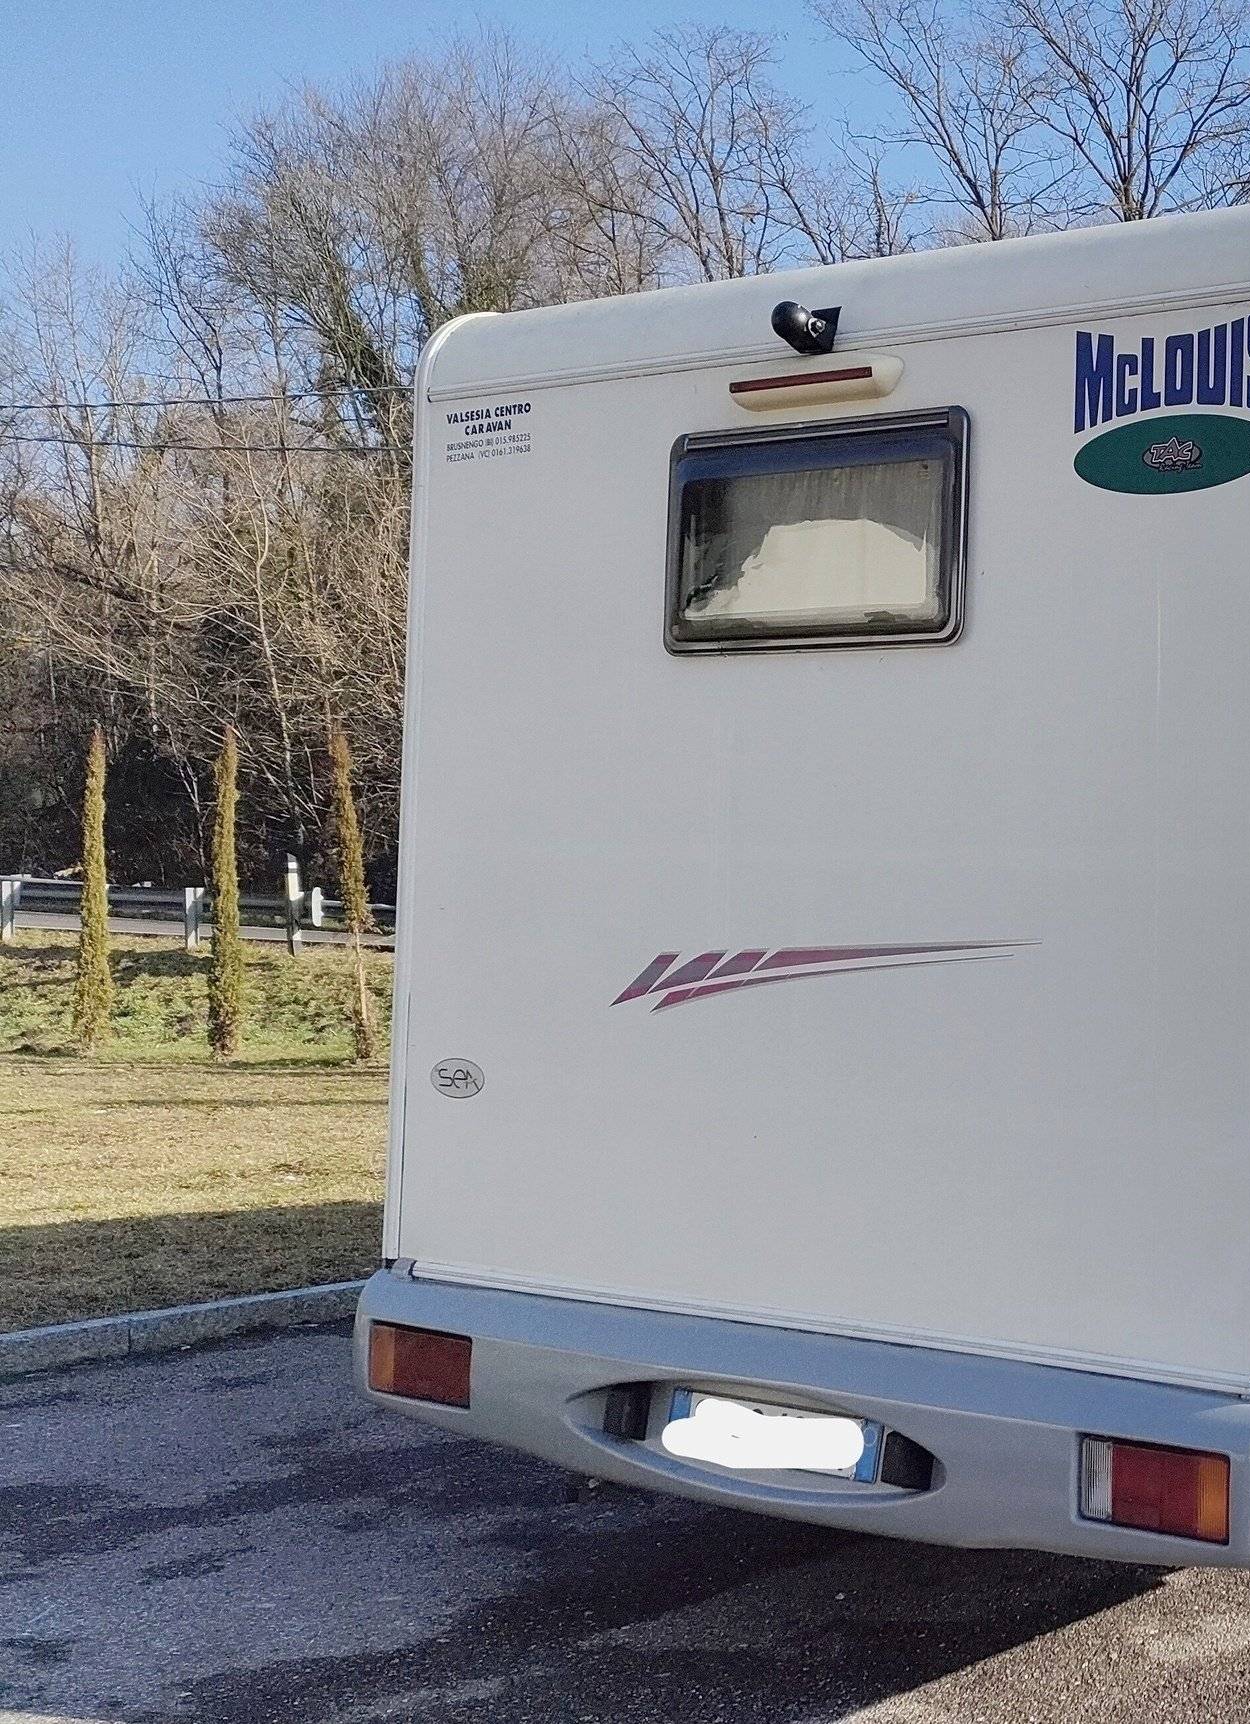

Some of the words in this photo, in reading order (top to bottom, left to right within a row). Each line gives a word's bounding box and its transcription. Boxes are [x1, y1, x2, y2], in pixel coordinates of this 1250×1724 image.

[446, 408, 492, 424] VALSESIA
[494, 402, 532, 418] CENTRO
[464, 419, 512, 436] CARAVAN
[446, 439, 484, 452] BRUSNENGO
[446, 451, 475, 463] PEZZANA
